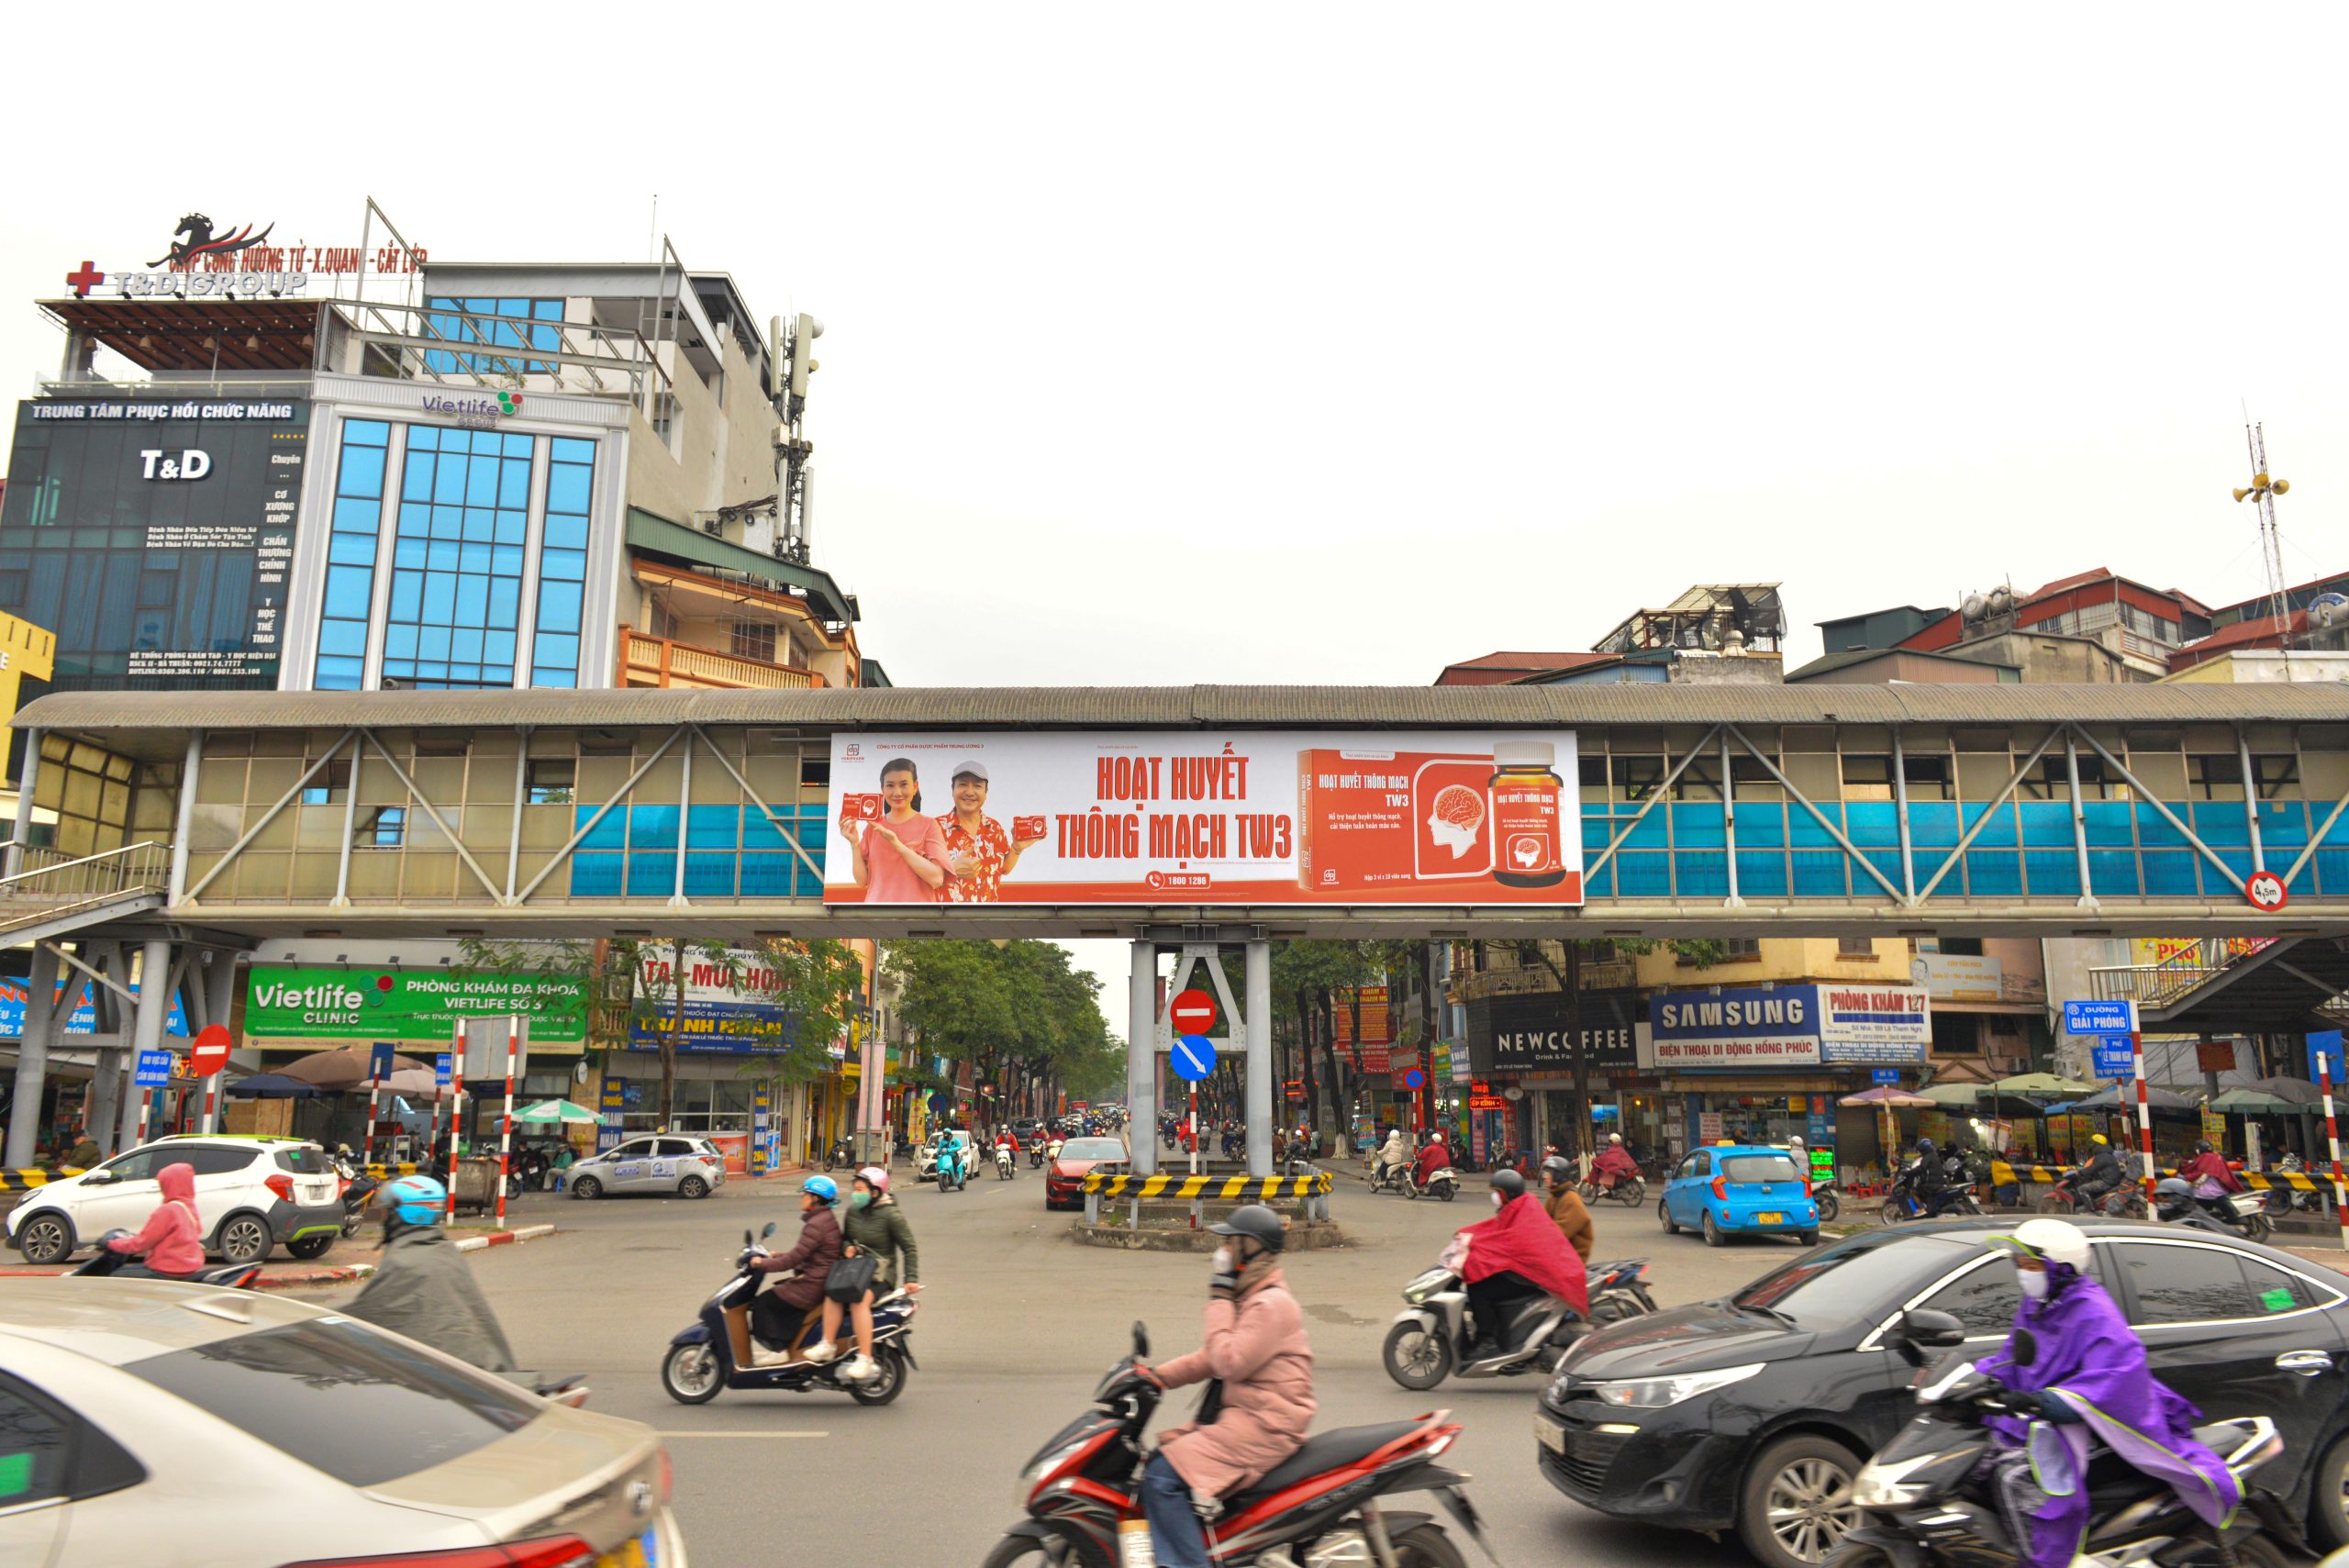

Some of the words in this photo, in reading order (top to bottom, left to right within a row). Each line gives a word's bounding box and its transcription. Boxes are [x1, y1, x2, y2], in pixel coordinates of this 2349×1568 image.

[113, 272, 177, 295] T&D
[185, 272, 306, 295] GROUP
[32, 405, 84, 419] TRUNG
[89, 403, 121, 419] TÂM
[126, 404, 169, 421] PHỤC
[172, 401, 199, 418] HỒI
[201, 403, 243, 418] CHỨC
[247, 403, 292, 418] NĂNG
[422, 395, 500, 417] Vietlife
[140, 449, 211, 479] T&D
[251, 634, 275, 644] THAO
[1097, 756, 1163, 811] HOẠT
[1171, 741, 1249, 800] HUYẾT
[1319, 773, 1338, 792] HOẠT
[1340, 770, 1362, 789] HUYẾT
[1364, 773, 1386, 789] THÔNG
[1388, 775, 1408, 792] MẠCH
[1386, 794, 1408, 807] TW3
[1540, 806, 1554, 815] TW3
[1055, 806, 1140, 858] THÔNG
[1149, 814, 1226, 870] MẠCH
[1235, 814, 1292, 859] TW3
[1168, 875, 1186, 885] 1800
[2254, 884, 2277, 900] 4,5m
[662, 947, 696, 956] PHNG
[255, 983, 363, 1010] Vietlife
[406, 979, 460, 993] PHÒNG
[463, 980, 508, 995] KHÁM
[512, 984, 533, 995] ĐA
[537, 984, 579, 995] KHOA
[444, 996, 507, 1009] VIETLIFE
[509, 995, 530, 1010] SỐ
[1830, 988, 1869, 1011] PHÒNG
[1872, 989, 1905, 1012] KHÁM
[1906, 994, 1926, 1013] 127
[683, 1008, 706, 1017] THUỐC
[1662, 998, 1805, 1029] SAMSUNG
[2085, 1005, 2120, 1013] ĐƯỜNG
[304, 1012, 360, 1024] CLINIC
[2071, 1013, 2091, 1029] GIẢI
[2093, 1014, 2126, 1029] PHÓNG
[1659, 1042, 1681, 1058] ĐIỆN
[1684, 1045, 1710, 1058] THOẠI
[1713, 1044, 1723, 1055] DI
[1726, 1041, 1753, 1057] ĐỘNG
[1755, 1039, 1782, 1054] HỒNG
[1786, 1040, 1813, 1053] PHÚC
